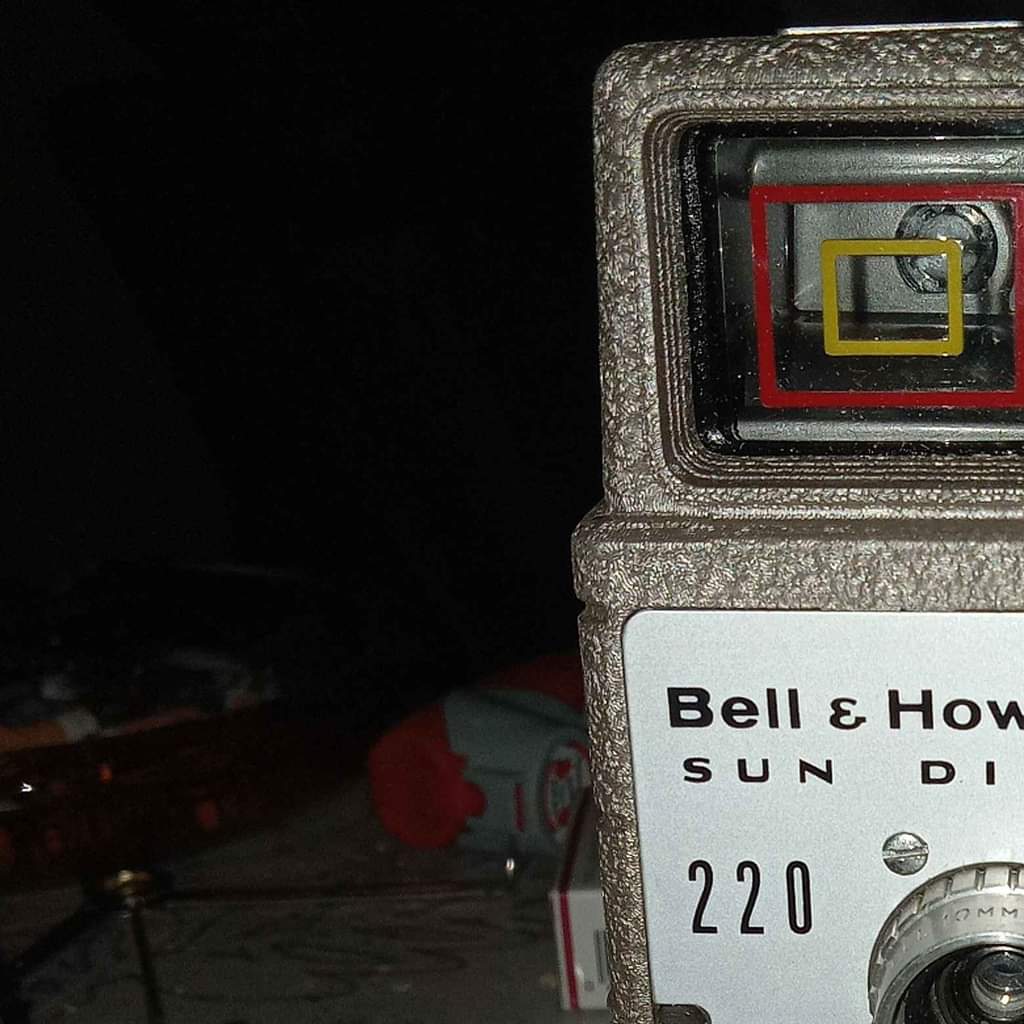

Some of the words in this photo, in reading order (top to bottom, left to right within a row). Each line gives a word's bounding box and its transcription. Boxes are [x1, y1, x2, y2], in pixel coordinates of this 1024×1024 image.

[667, 687, 801, 729] Bell
[829, 697, 867, 730] &
[683, 758, 833, 784] SUN
[689, 860, 813, 935] 220
